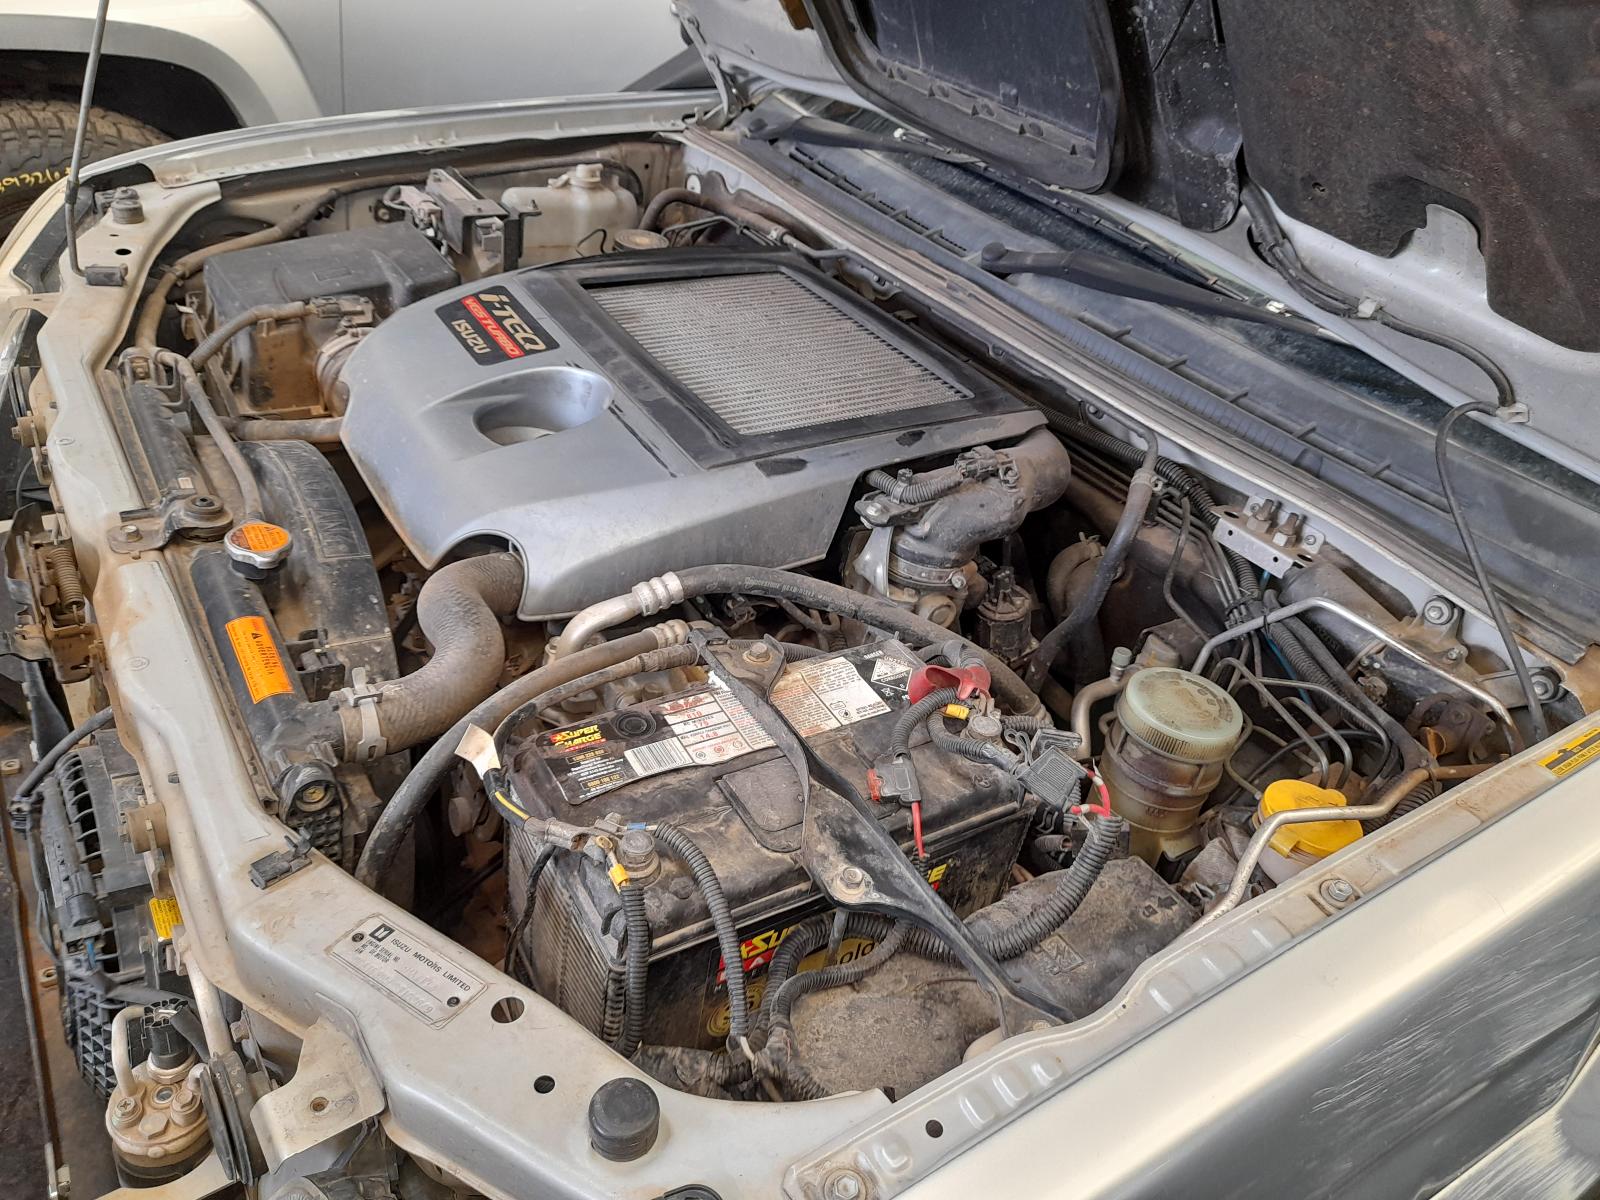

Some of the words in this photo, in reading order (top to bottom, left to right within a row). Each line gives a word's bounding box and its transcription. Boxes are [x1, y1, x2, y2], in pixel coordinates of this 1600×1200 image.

[451, 319, 492, 354] ISUZU
[464, 299, 486, 319] VGS
[481, 317, 520, 355] TURBO
[391, 938, 412, 953] ISUZU
[413, 951, 442, 973] MOTORS
[442, 970, 471, 992] LIMITED
[839, 941, 876, 965] old
